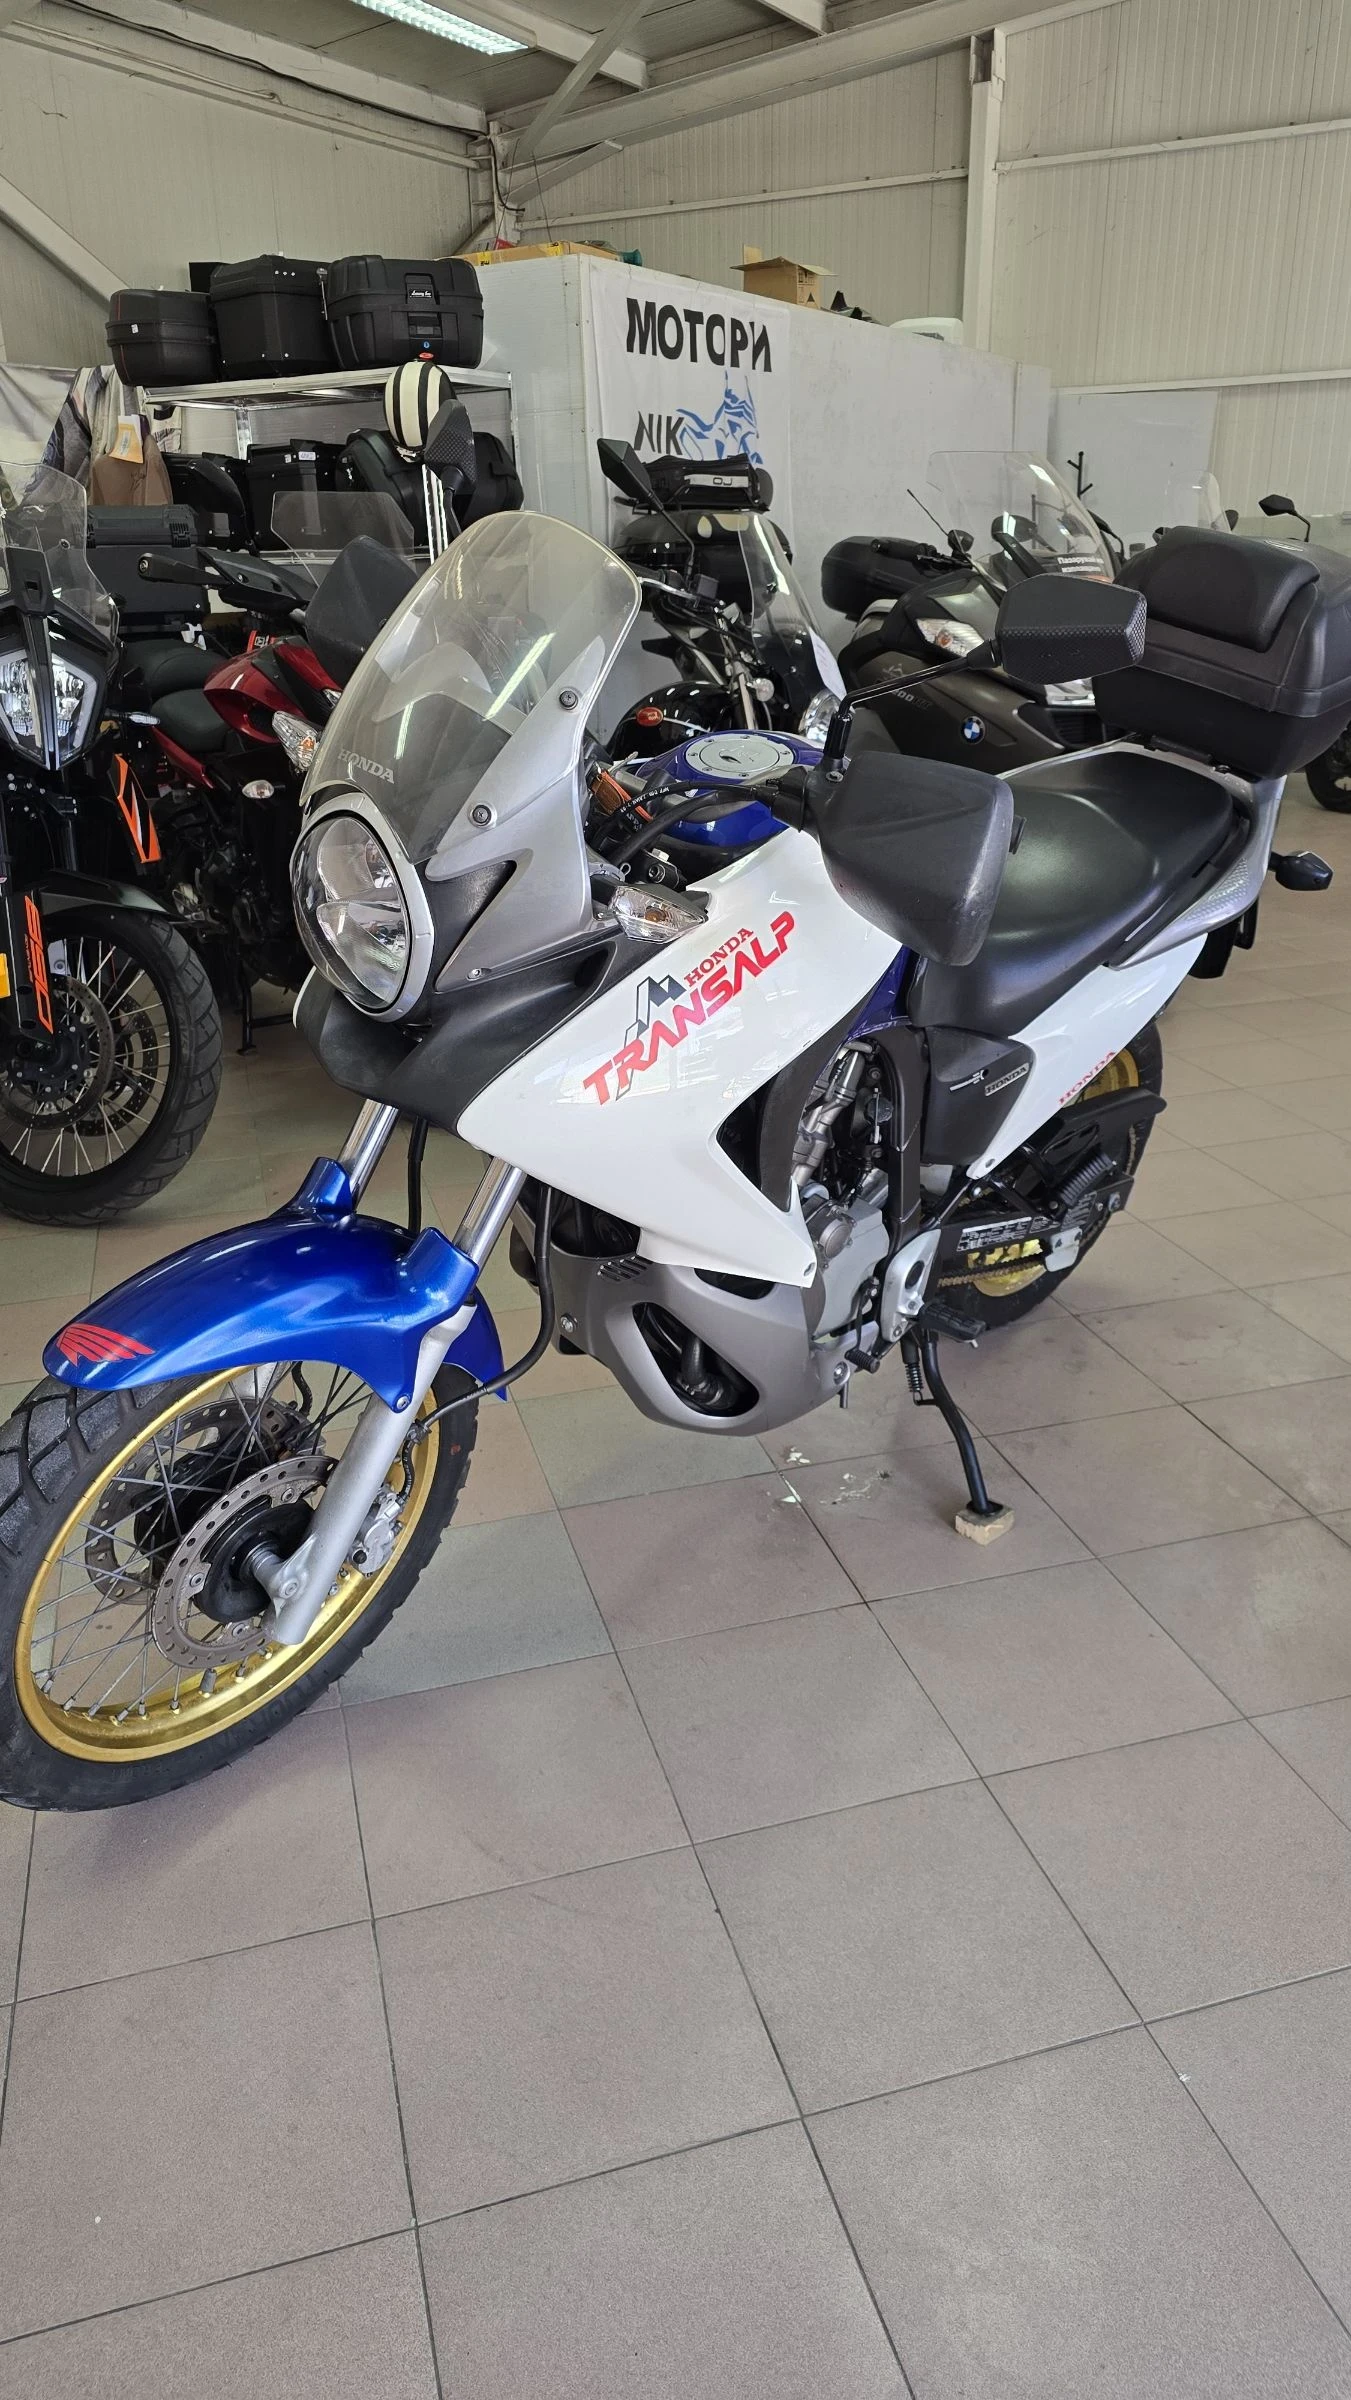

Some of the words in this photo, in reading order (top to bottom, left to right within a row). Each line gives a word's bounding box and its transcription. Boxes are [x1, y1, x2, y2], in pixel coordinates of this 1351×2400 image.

[626, 297, 772, 372] МОТОРИ
[633, 410, 685, 456] NIK
[712, 476, 733, 486] OJ
[337, 748, 395, 784] HONDA
[25, 895, 54, 1035] 890
[683, 927, 754, 987] HONDA
[582, 911, 795, 1106] TRANSALP
[985, 1066, 1027, 1094] HONDA
[1058, 1051, 1116, 1104] HONDA
